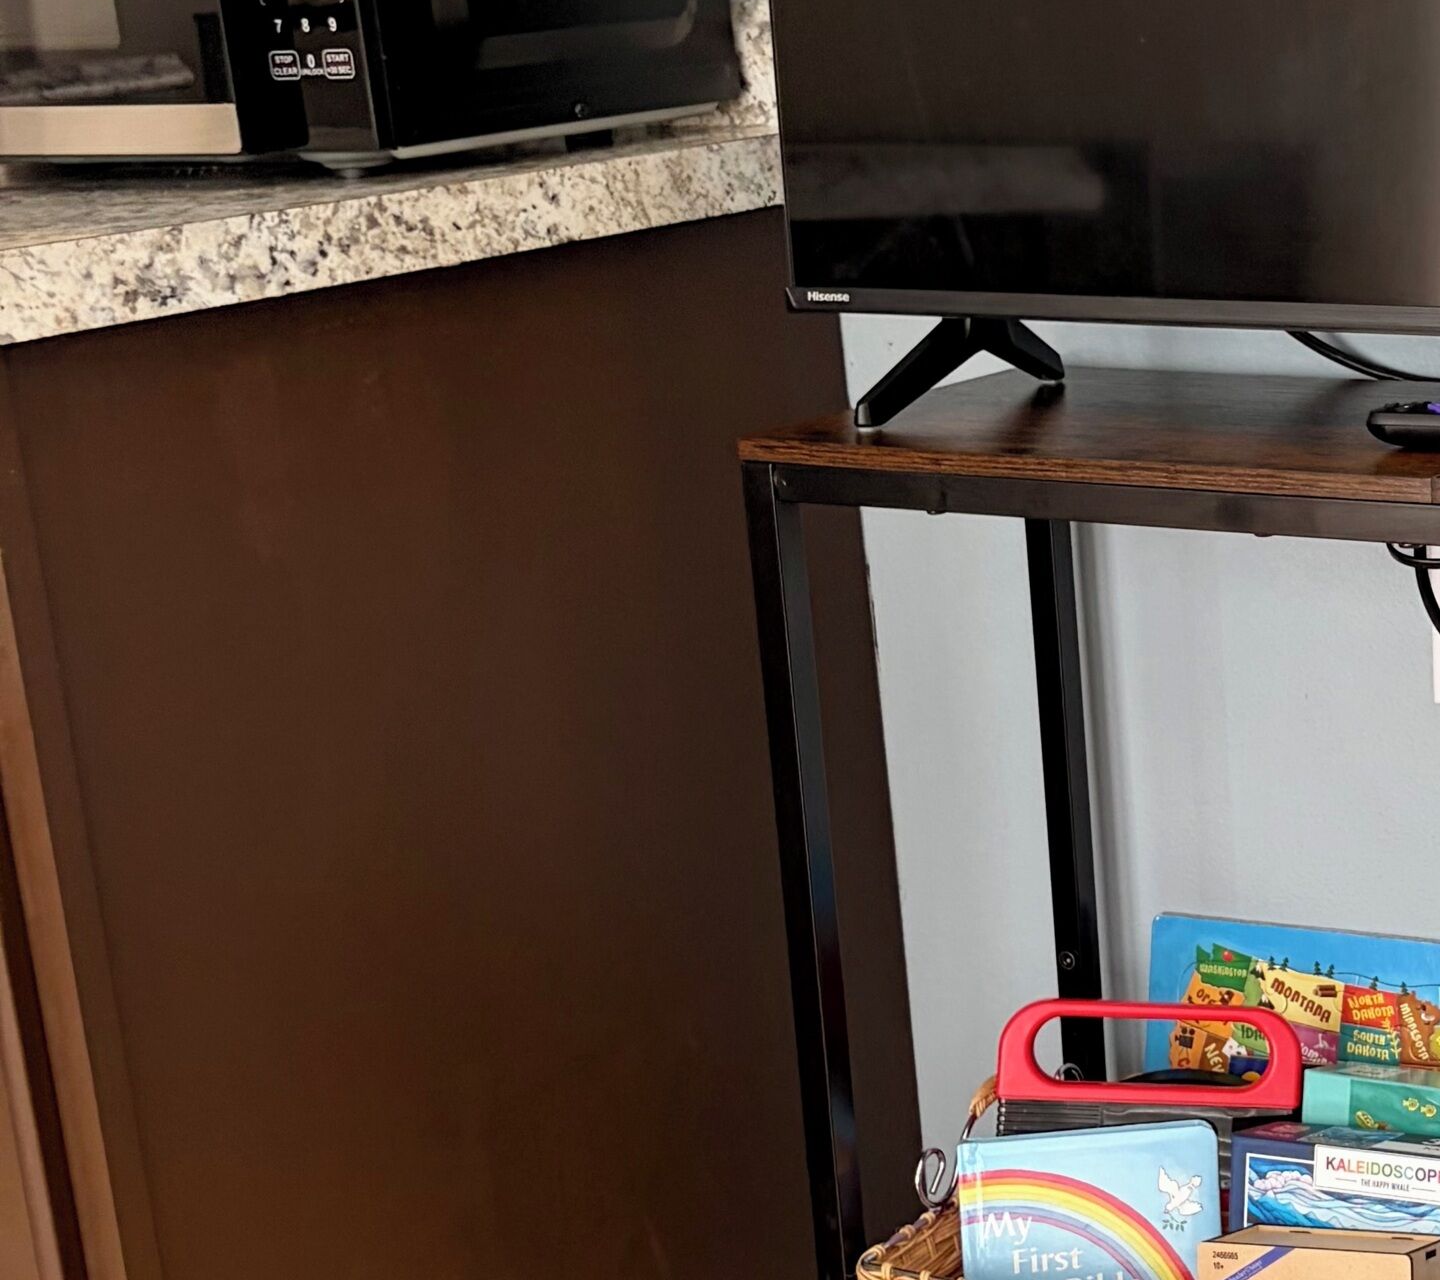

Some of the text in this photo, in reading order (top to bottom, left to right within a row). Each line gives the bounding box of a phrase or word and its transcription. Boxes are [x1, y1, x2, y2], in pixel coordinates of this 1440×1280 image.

[274, 16, 338, 33] 7 8 9
[274, 55, 294, 64] STOP
[306, 53, 316, 68] 0
[326, 53, 350, 63] START
[273, 66, 298, 76] CLEAR
[807, 291, 850, 302] Hisense
[1352, 1005, 1395, 1021] DAKOTA
[1347, 1041, 1390, 1061] DAKOTA
[1361, 1179, 1410, 1192] THE HAPPY WHALE
[984, 1211, 1032, 1246] My
[1011, 1247, 1084, 1274] First
